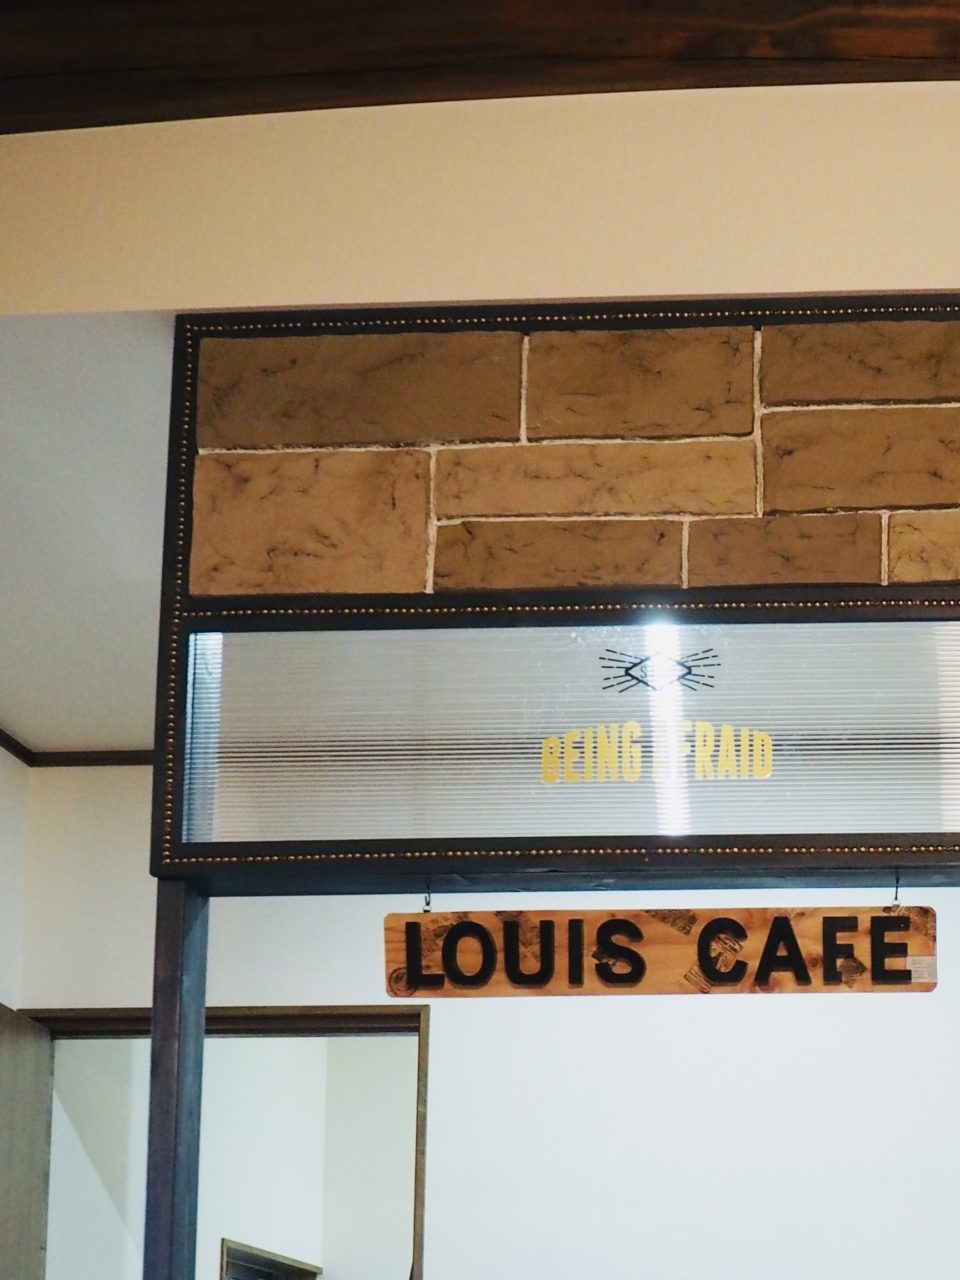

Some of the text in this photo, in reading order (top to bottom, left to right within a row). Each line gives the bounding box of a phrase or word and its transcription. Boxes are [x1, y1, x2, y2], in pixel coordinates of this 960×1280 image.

[541, 720, 773, 784] BEING FRAID
[405, 914, 913, 990] LOUIS CAFE
